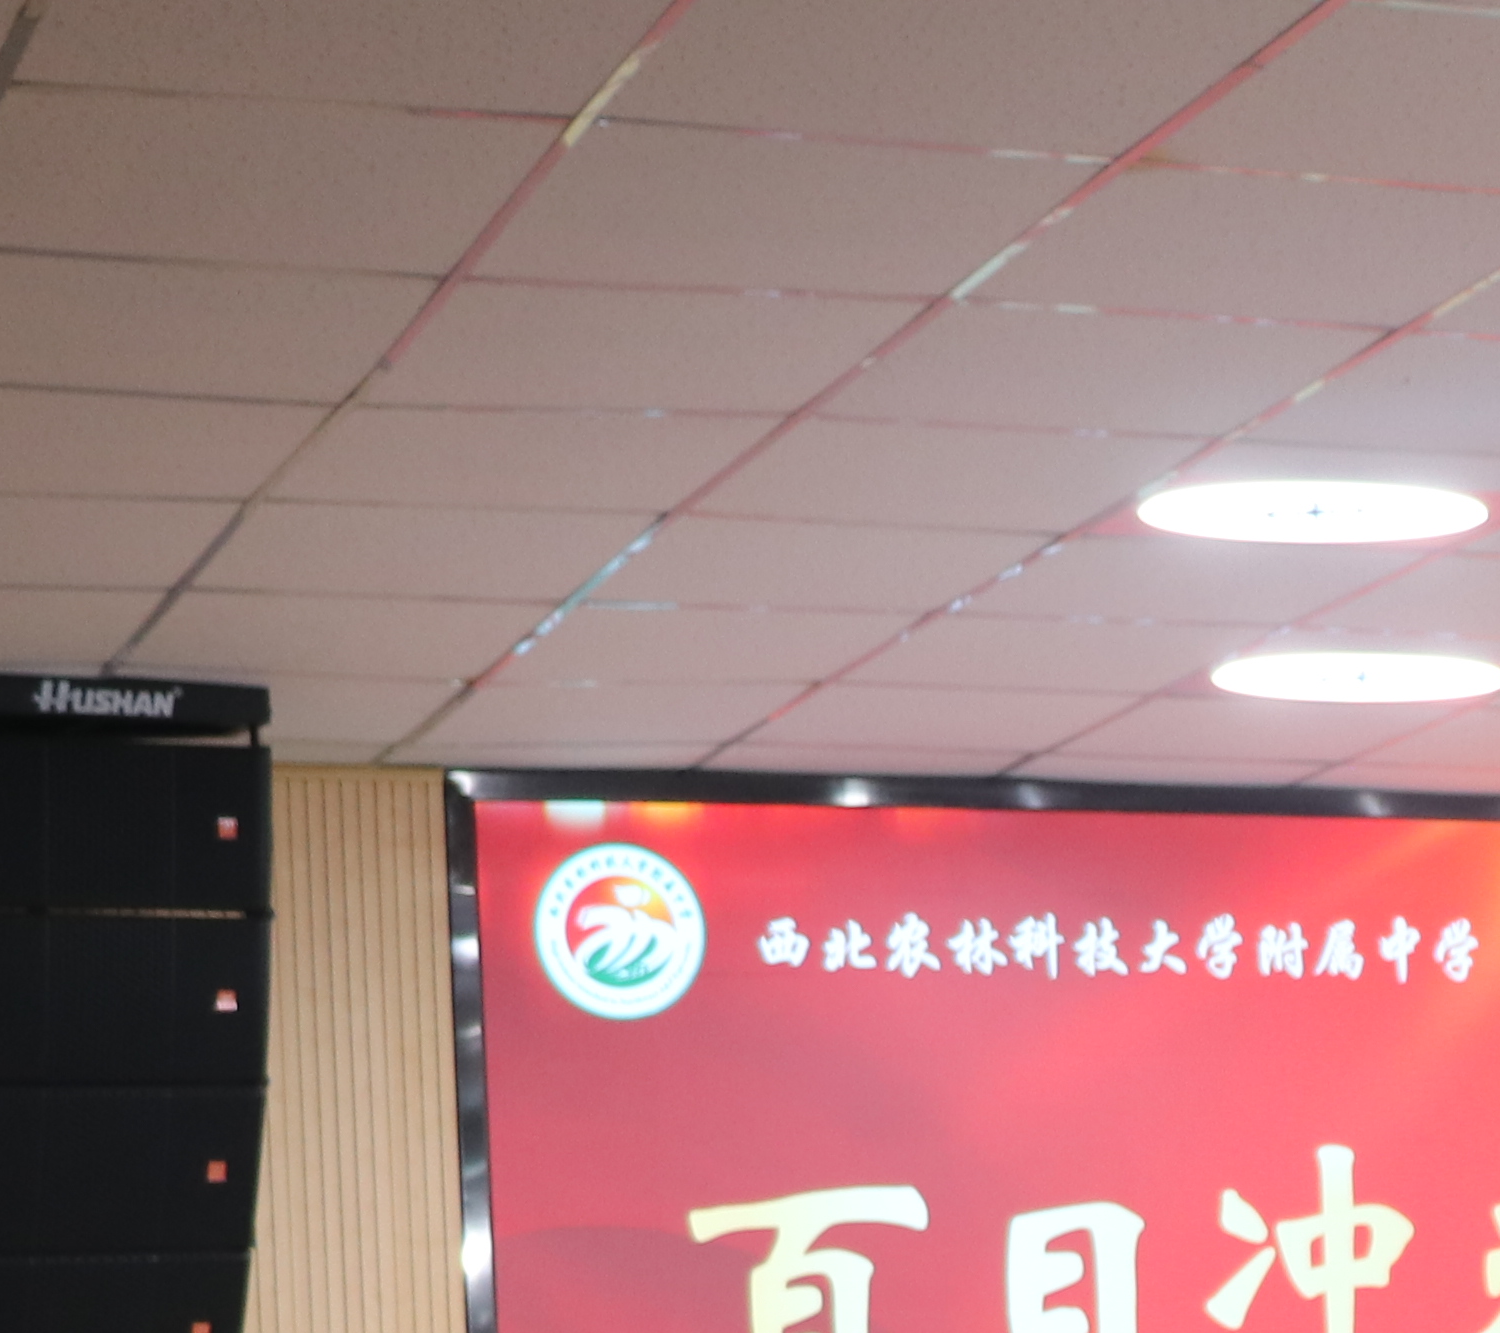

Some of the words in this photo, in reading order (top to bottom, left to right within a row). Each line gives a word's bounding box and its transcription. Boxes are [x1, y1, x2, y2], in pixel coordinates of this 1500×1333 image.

[33, 680, 175, 718] HUSHAN
[757, 911, 1480, 984] 西北农林科技大学附属中学
